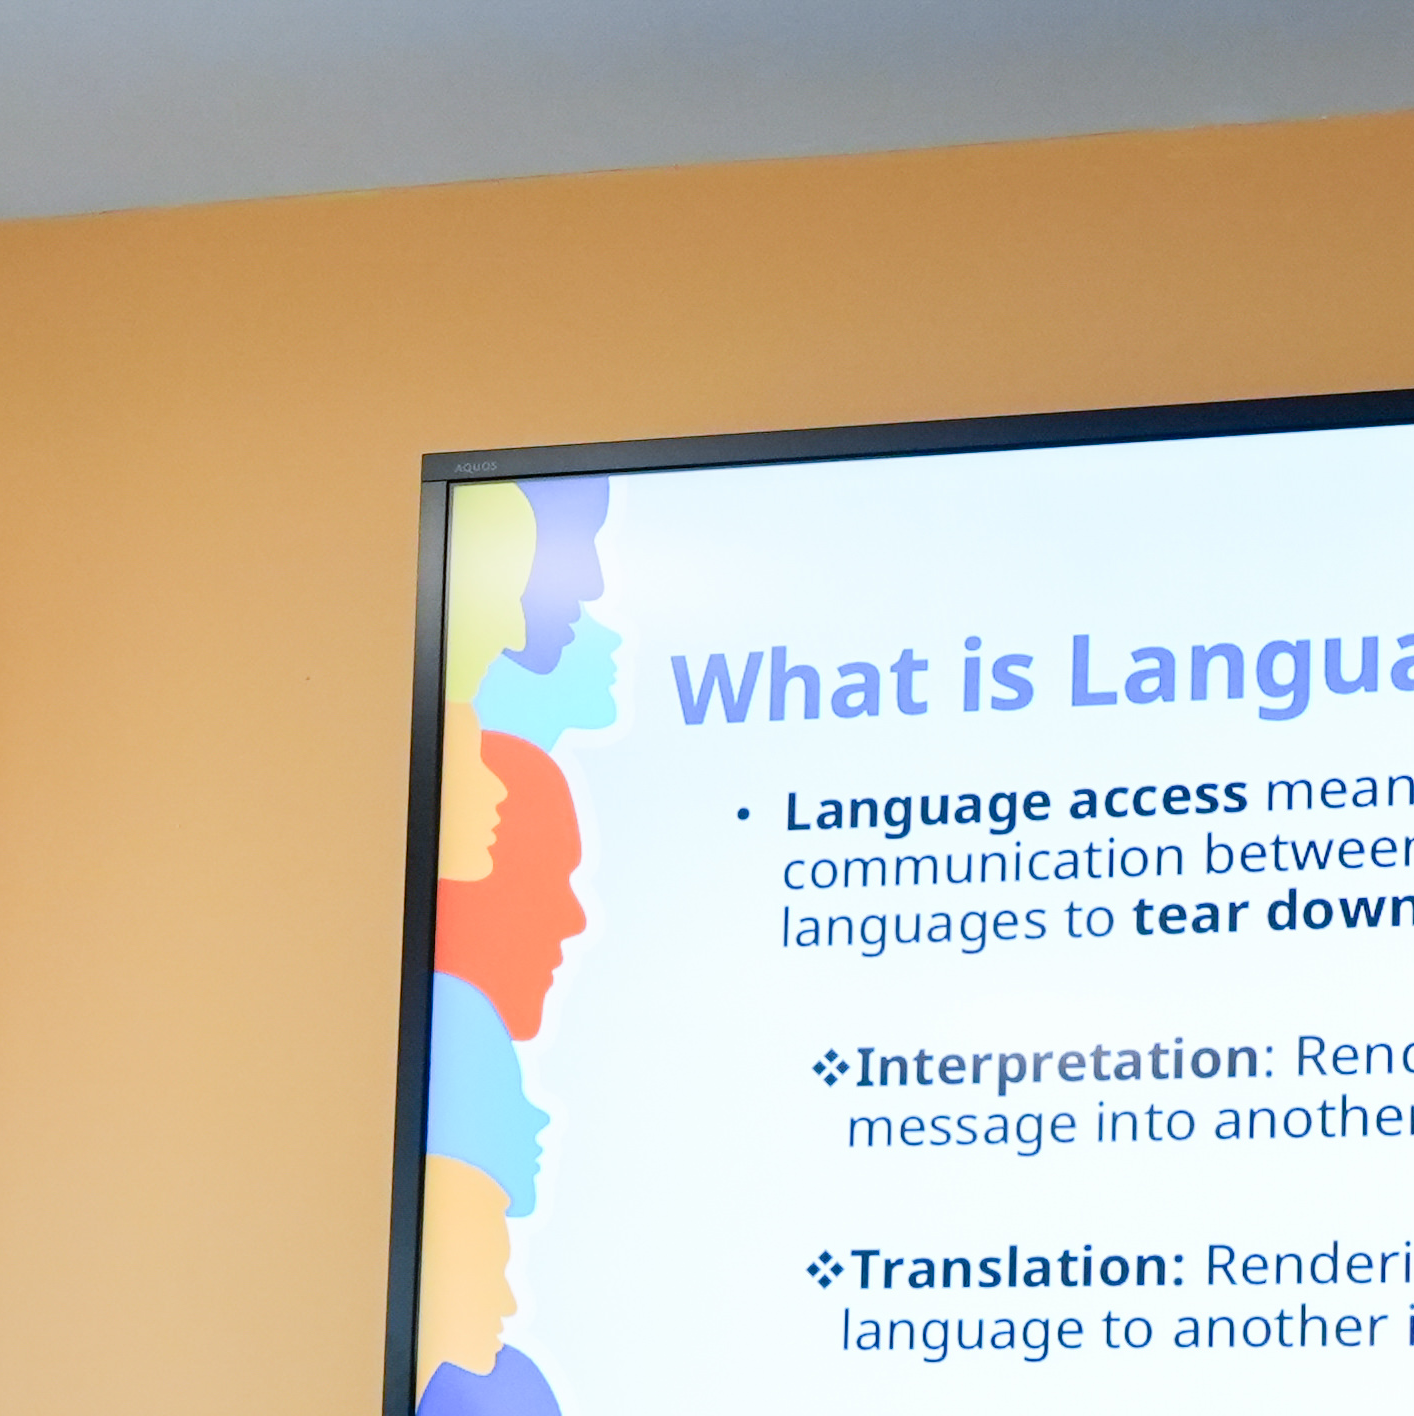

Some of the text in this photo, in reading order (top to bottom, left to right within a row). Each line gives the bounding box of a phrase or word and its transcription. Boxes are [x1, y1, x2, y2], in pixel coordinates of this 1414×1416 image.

[454, 461, 498, 475] AQUOS
[671, 644, 929, 726] What
[962, 636, 1035, 712] is
[787, 790, 1051, 839] Language
[1069, 780, 1248, 820] access
[783, 836, 1185, 890] communication
[781, 902, 1047, 958] languages
[1065, 900, 1115, 939] to
[1133, 894, 1250, 936] tear
[855, 1036, 1274, 1097] Interpretation:
[849, 1110, 1077, 1156] message
[1097, 1100, 1197, 1144] into
[851, 1244, 1184, 1289] Translation:
[843, 1308, 1083, 1362] language
[1103, 1310, 1153, 1350] to
[1173, 1304, 1389, 1348] another
